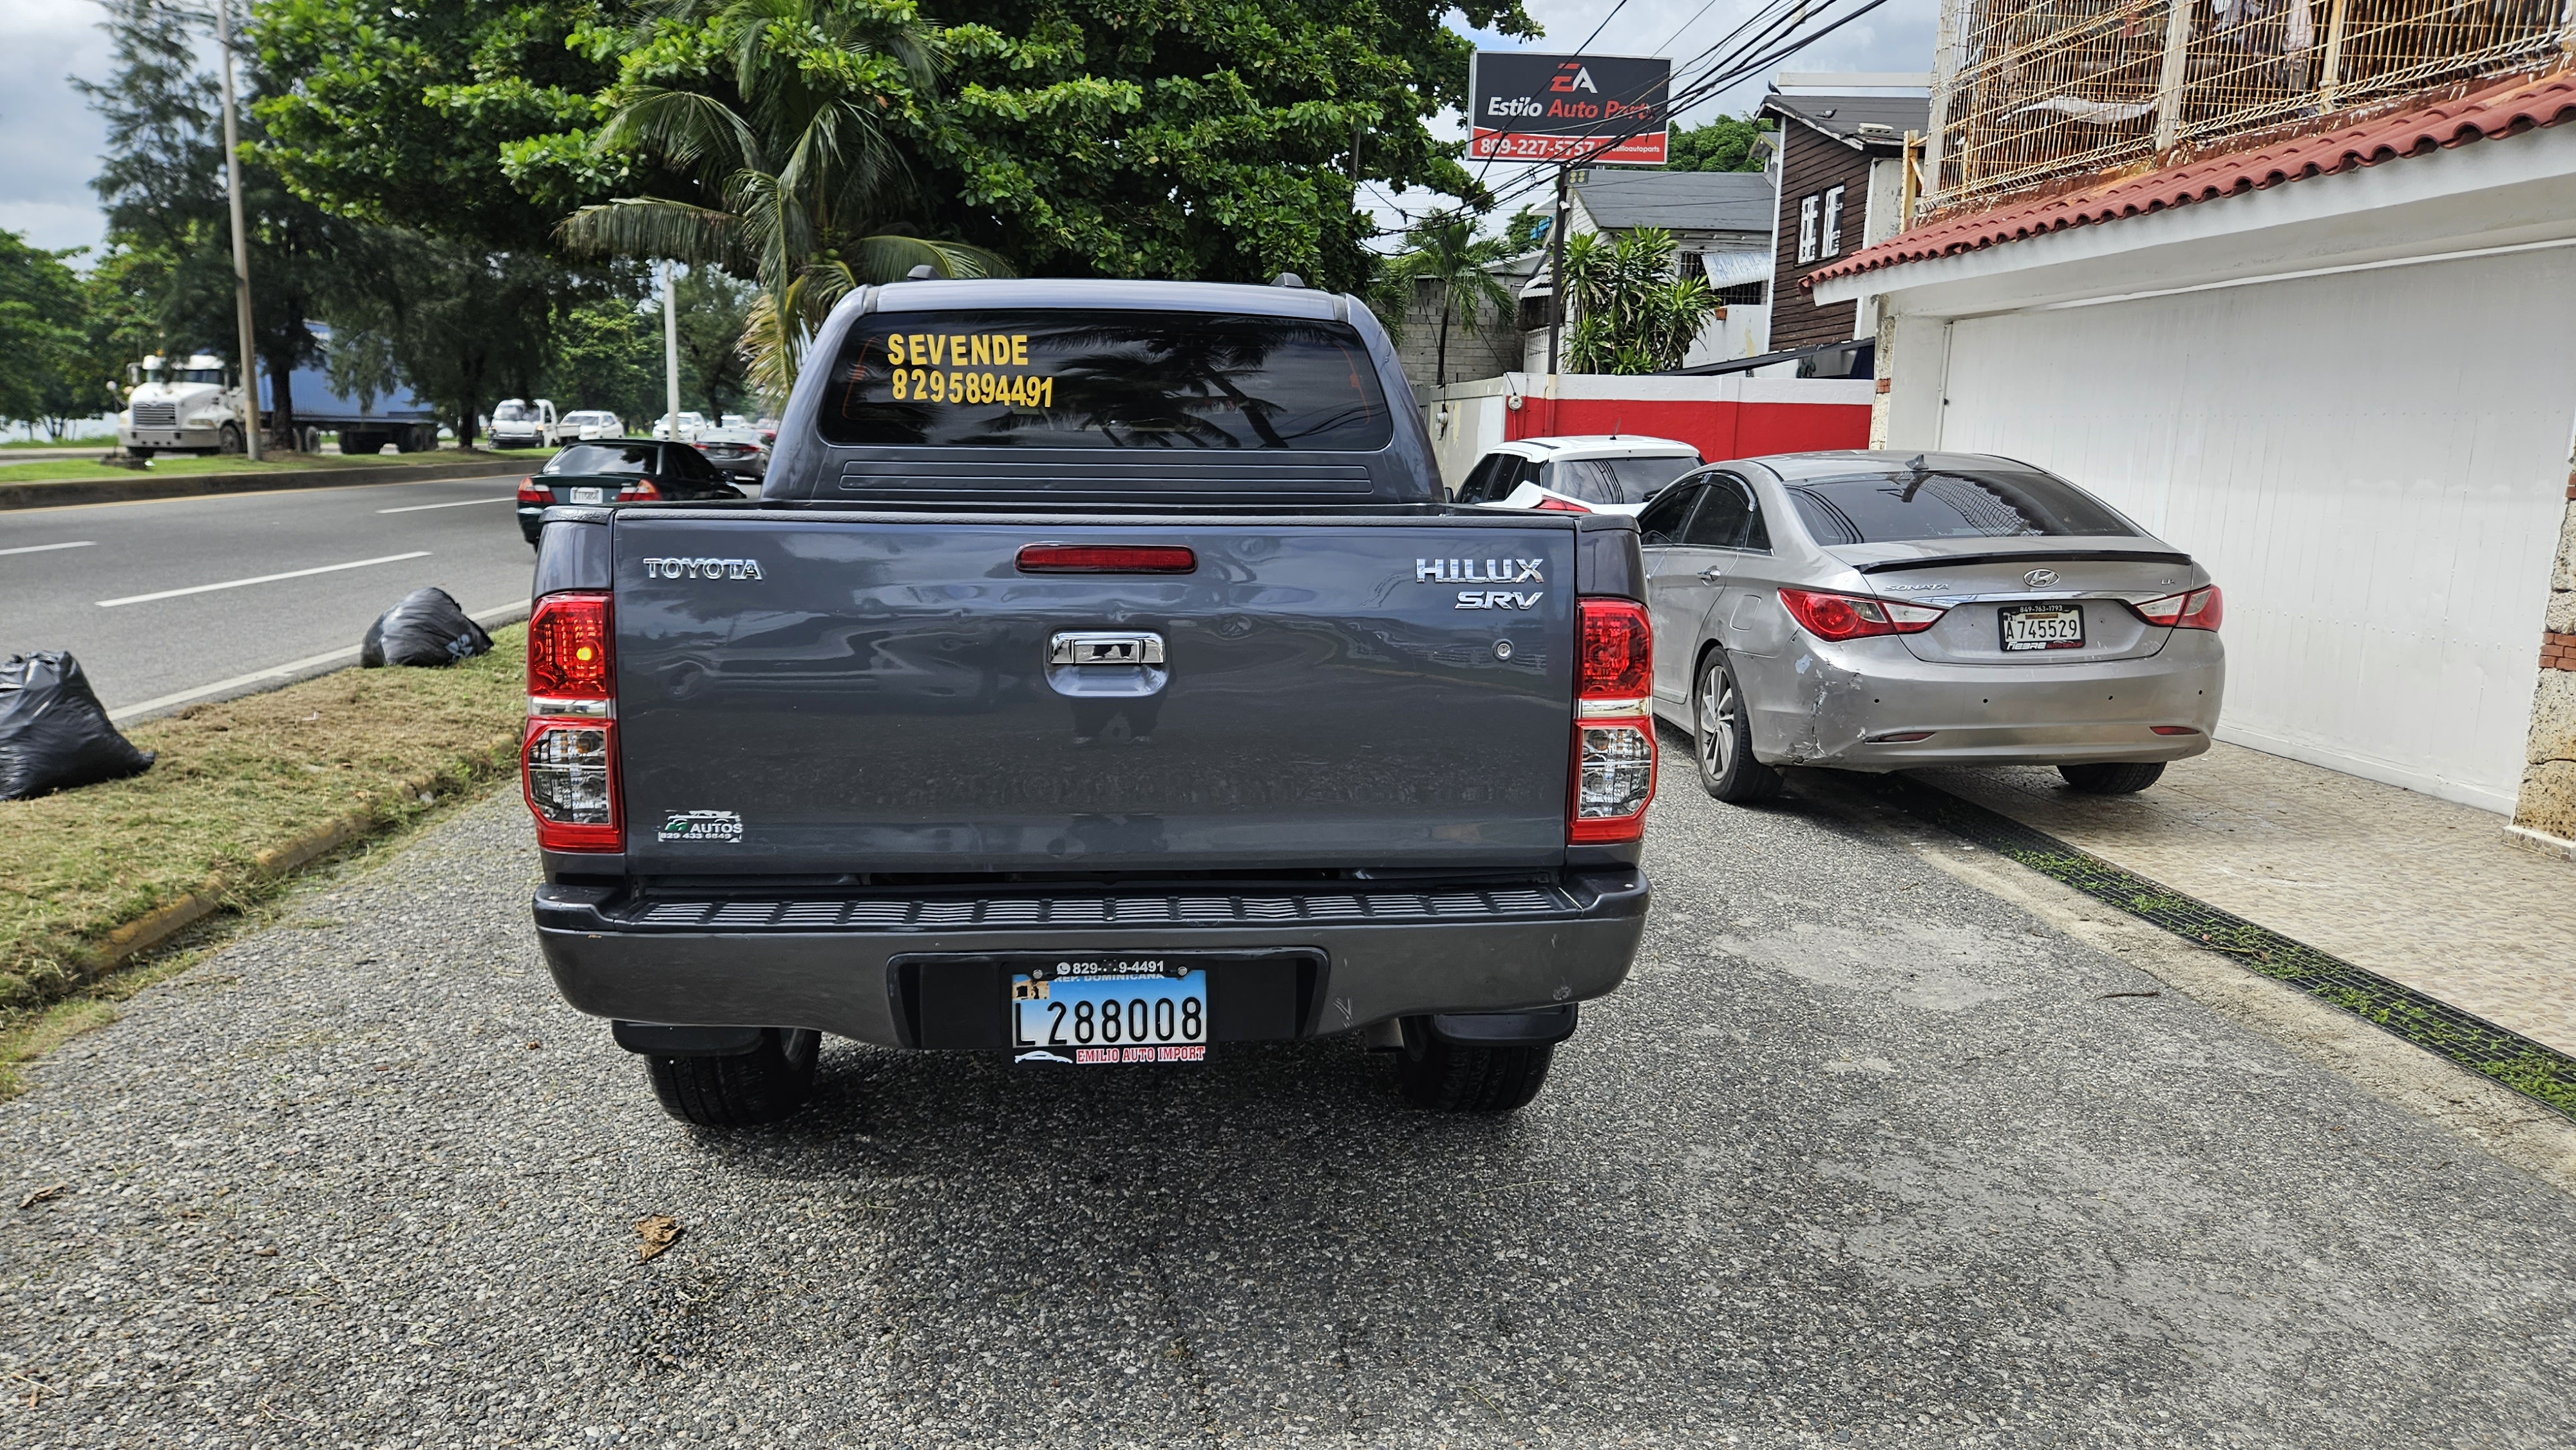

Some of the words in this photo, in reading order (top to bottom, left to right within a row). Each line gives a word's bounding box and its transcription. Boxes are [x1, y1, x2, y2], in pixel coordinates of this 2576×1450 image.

[1487, 97, 1543, 117] Estilo
[1546, 99, 1598, 118] Auto
[1480, 138, 1595, 156] 809-227-5757
[893, 368, 1053, 408] 8295894491
[643, 557, 762, 580] TOYOTA
[1416, 558, 1544, 583] HILUX
[1454, 590, 1544, 610] SRV
[2020, 605, 2063, 613] 849-763-1793
[2006, 619, 2078, 639] A745529
[690, 823, 743, 834] AUTOS
[1072, 961, 1164, 974] 829-9-4491
[1016, 997, 1202, 1046] L288008
[1076, 1048, 1119, 1064] EMILIO
[1122, 1048, 1155, 1062] AUTO
[1157, 1046, 1206, 1062] IMPORT
